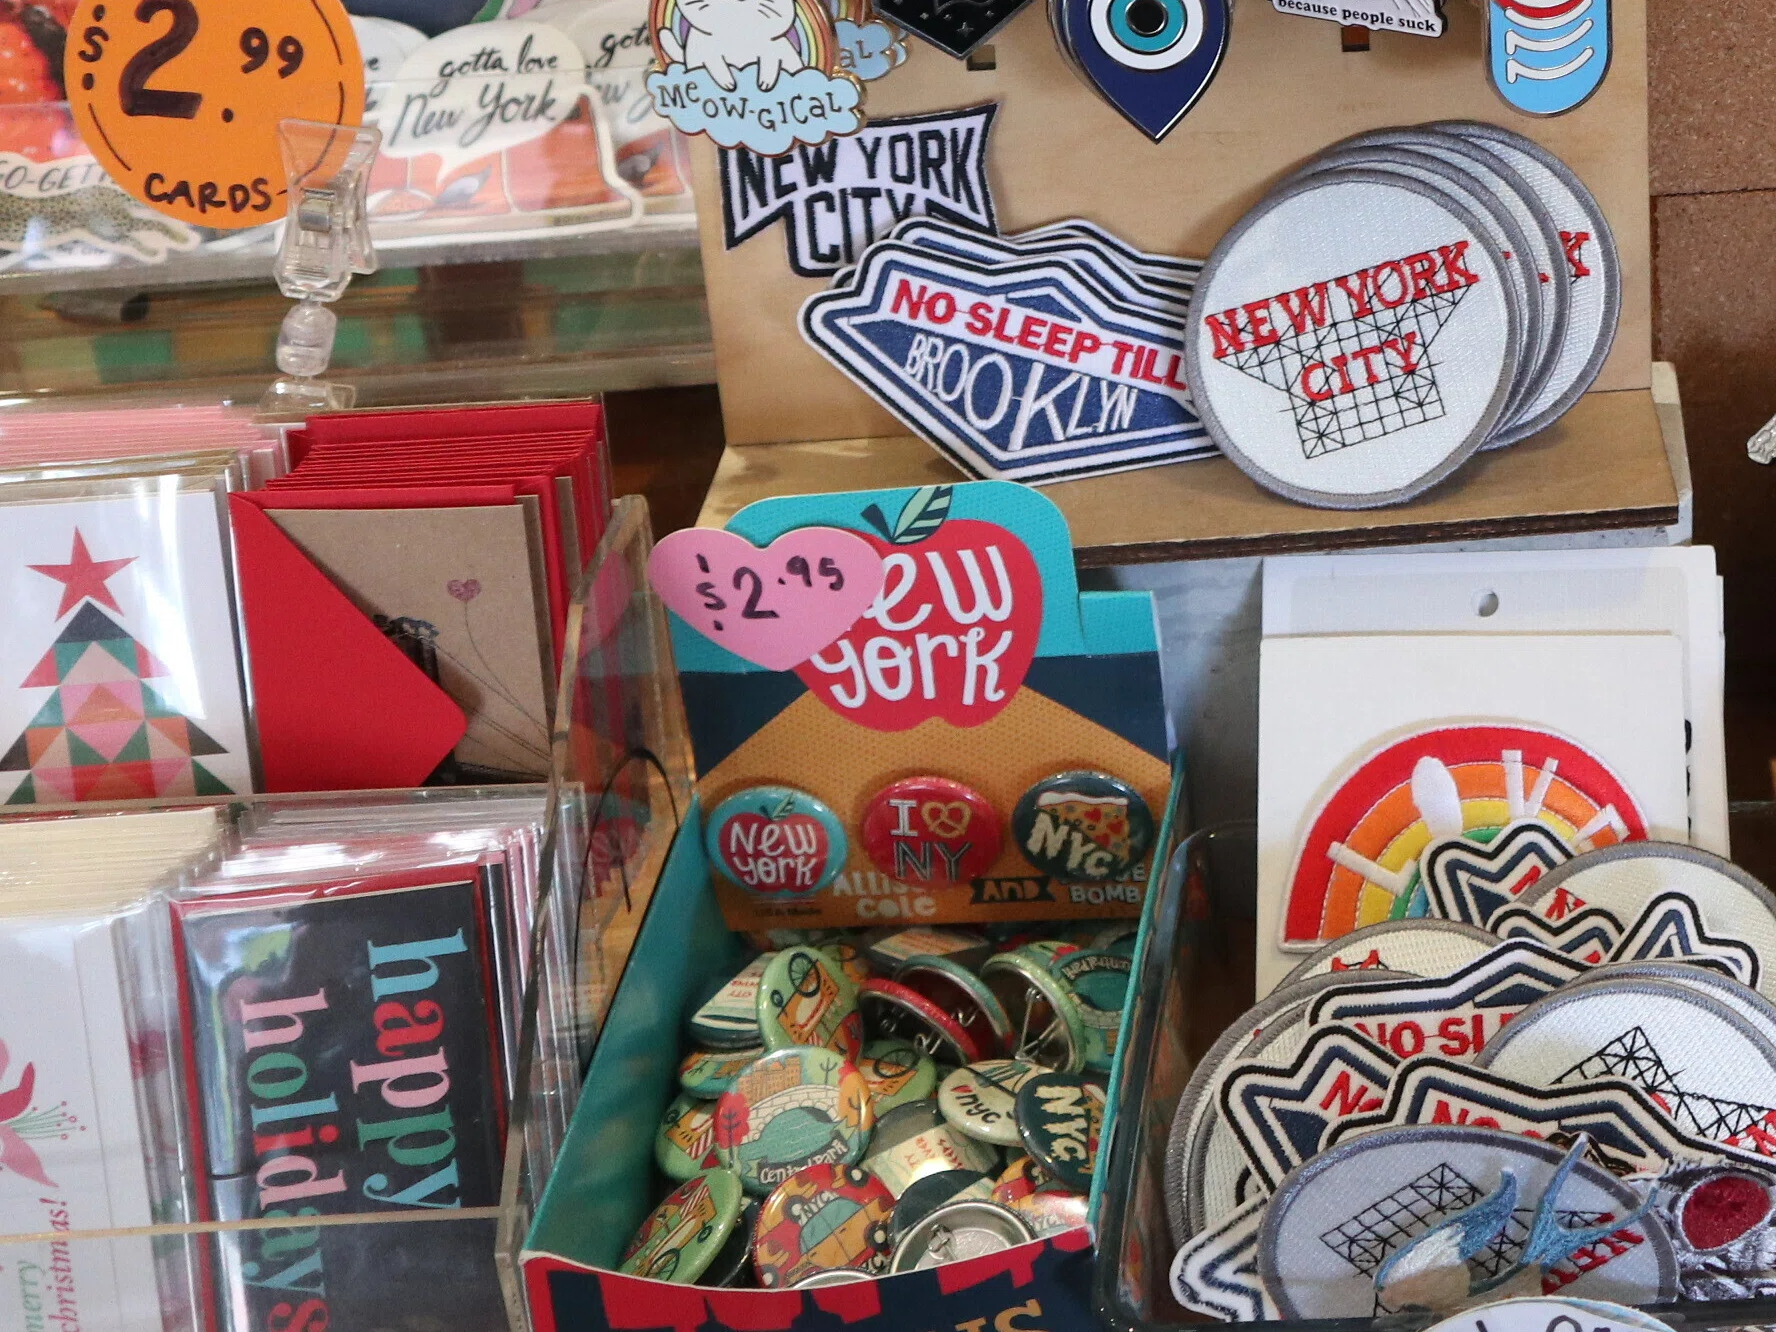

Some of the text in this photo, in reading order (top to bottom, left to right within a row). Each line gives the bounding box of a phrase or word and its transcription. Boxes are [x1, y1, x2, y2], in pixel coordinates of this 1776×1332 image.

[1342, 6, 1395, 29] people
[1398, 14, 1436, 33] suck
[439, 35, 559, 94] gotta love
[388, 80, 558, 147] New York
[144, 172, 273, 214] CARDS
[860, 126, 985, 218] YORK
[892, 277, 1188, 390] NO SLEEP TILL
[1203, 283, 1337, 360] NEW
[1334, 240, 1480, 318] YORK
[904, 333, 1139, 452] BROOKLYN
[1301, 331, 1426, 402] CITY
[888, 799, 918, 838] I
[1028, 814, 1114, 879] NYC
[894, 840, 974, 882] NY
[350, 926, 470, 1210] happy
[1035, 1084, 1090, 1162] NYC
